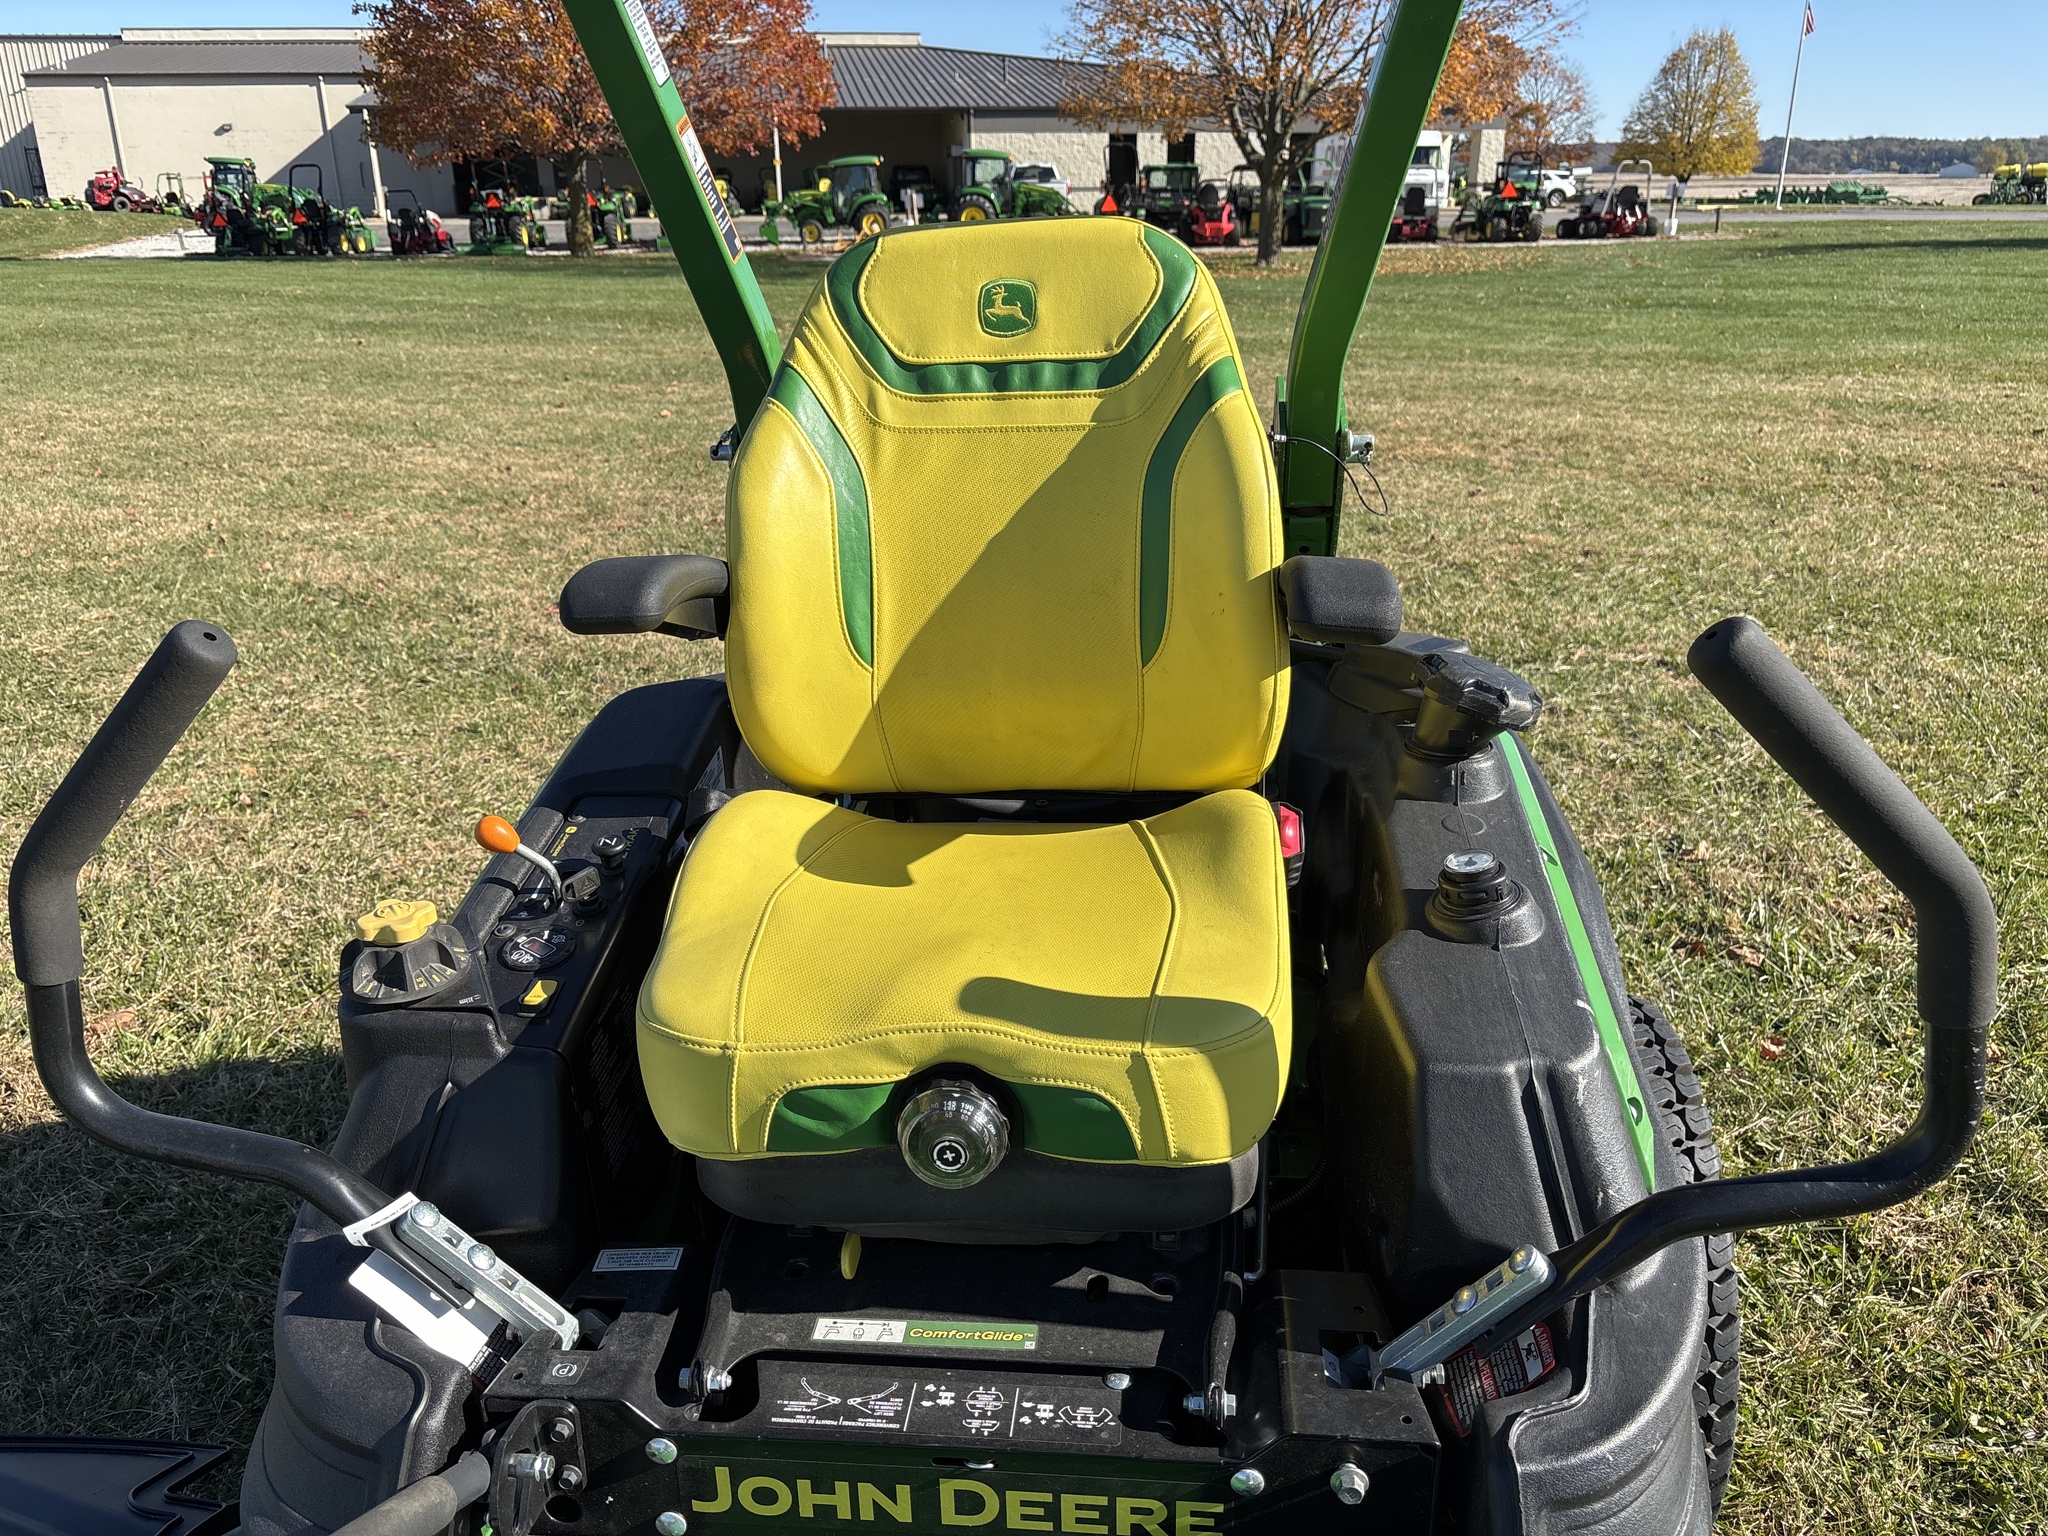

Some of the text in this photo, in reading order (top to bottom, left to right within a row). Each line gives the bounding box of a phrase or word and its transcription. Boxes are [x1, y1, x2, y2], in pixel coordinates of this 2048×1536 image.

[961, 1102, 975, 1111] 190
[1538, 1333, 1553, 1365] DANGER
[1479, 1364, 1496, 1399] PELIGRO
[691, 1466, 1225, 1536] JOHN DEERE
